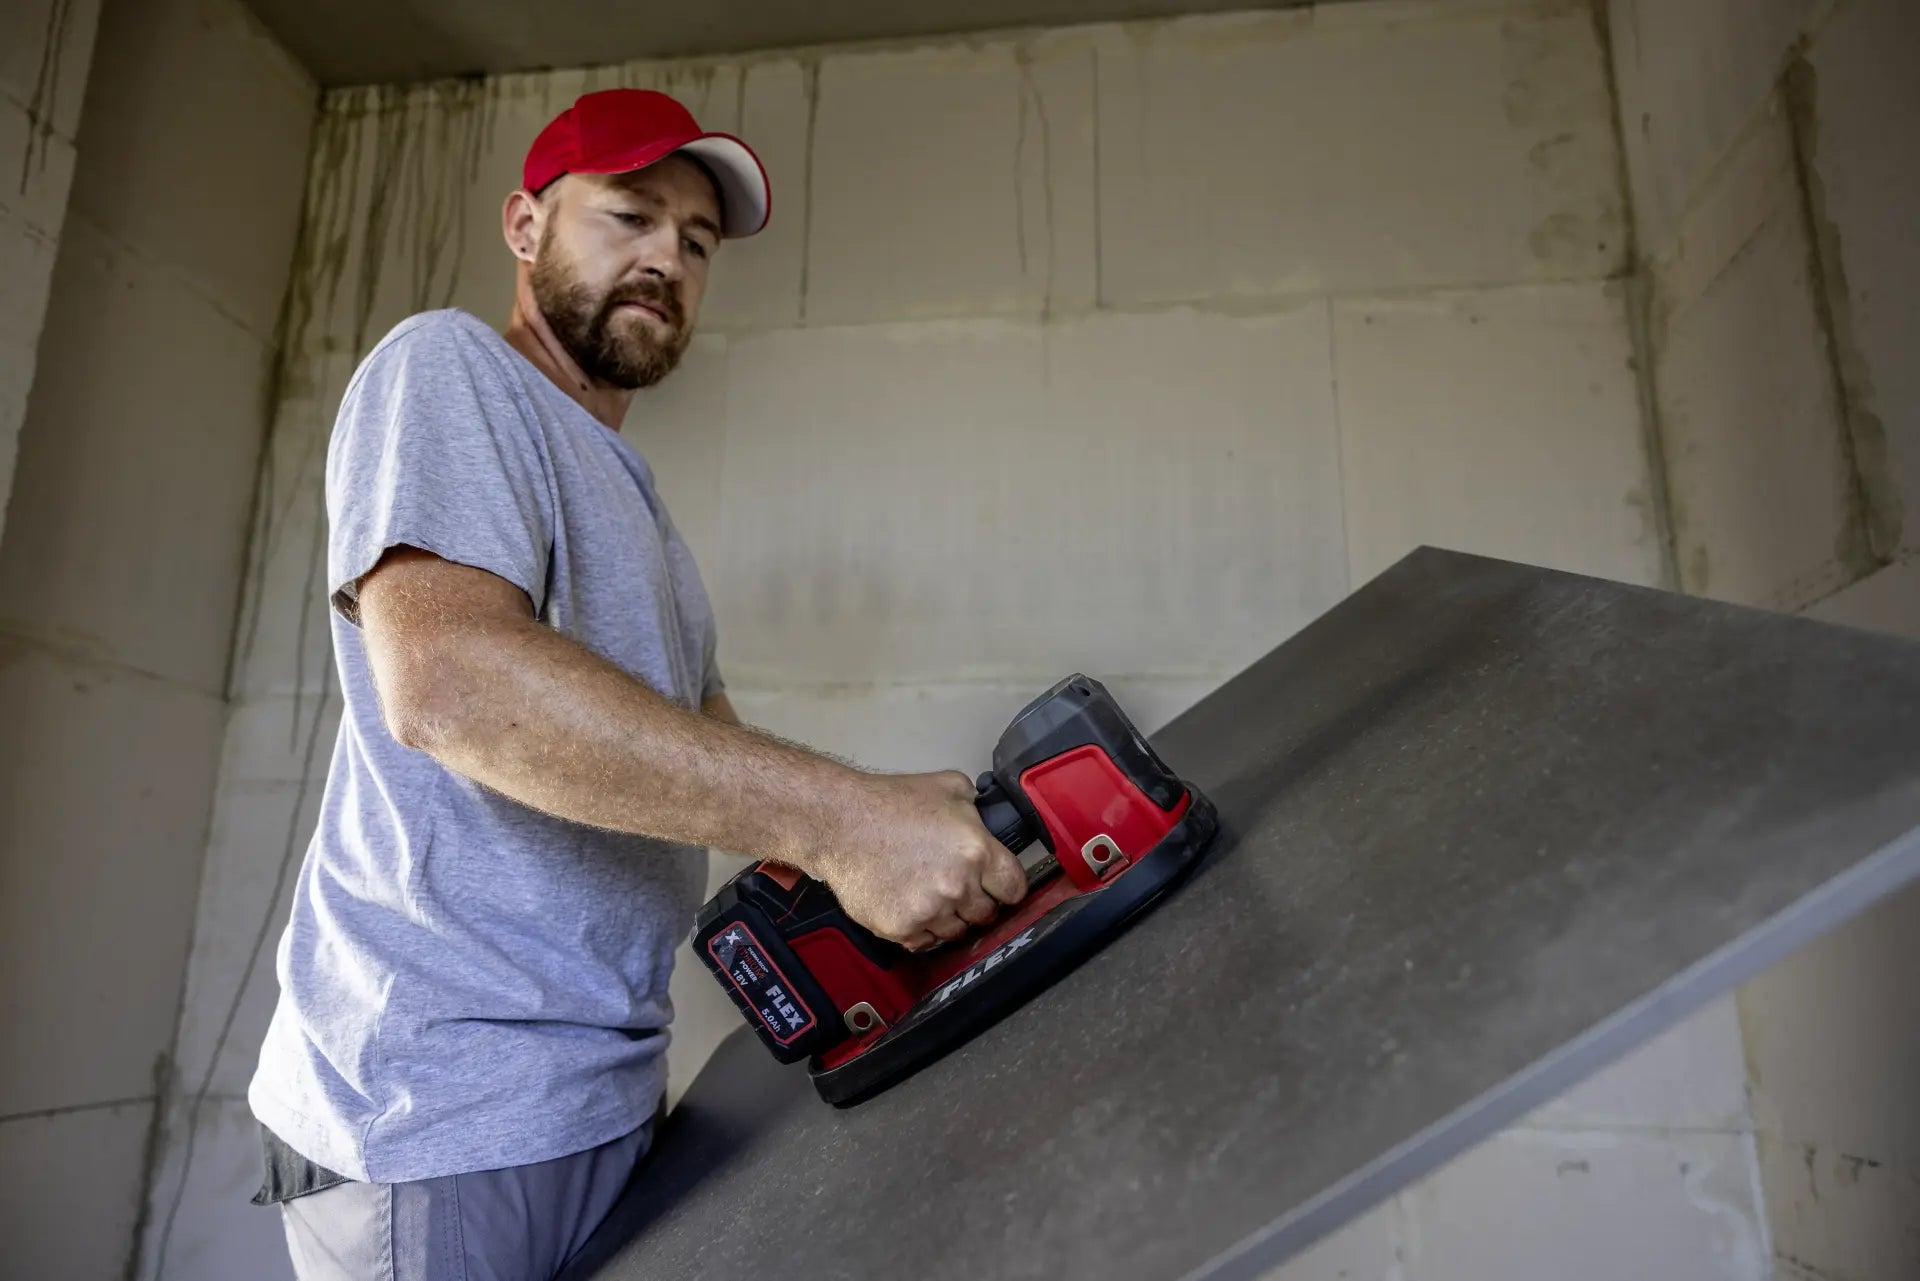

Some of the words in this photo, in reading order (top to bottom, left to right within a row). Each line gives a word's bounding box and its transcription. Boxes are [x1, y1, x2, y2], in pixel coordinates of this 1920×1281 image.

[733, 969, 748, 985] 18V
[740, 960, 757, 982] POWER
[940, 928, 1035, 1002] FLEX
[766, 985, 804, 1030] FLEX
[762, 1008, 781, 1032] 5.0Ah
